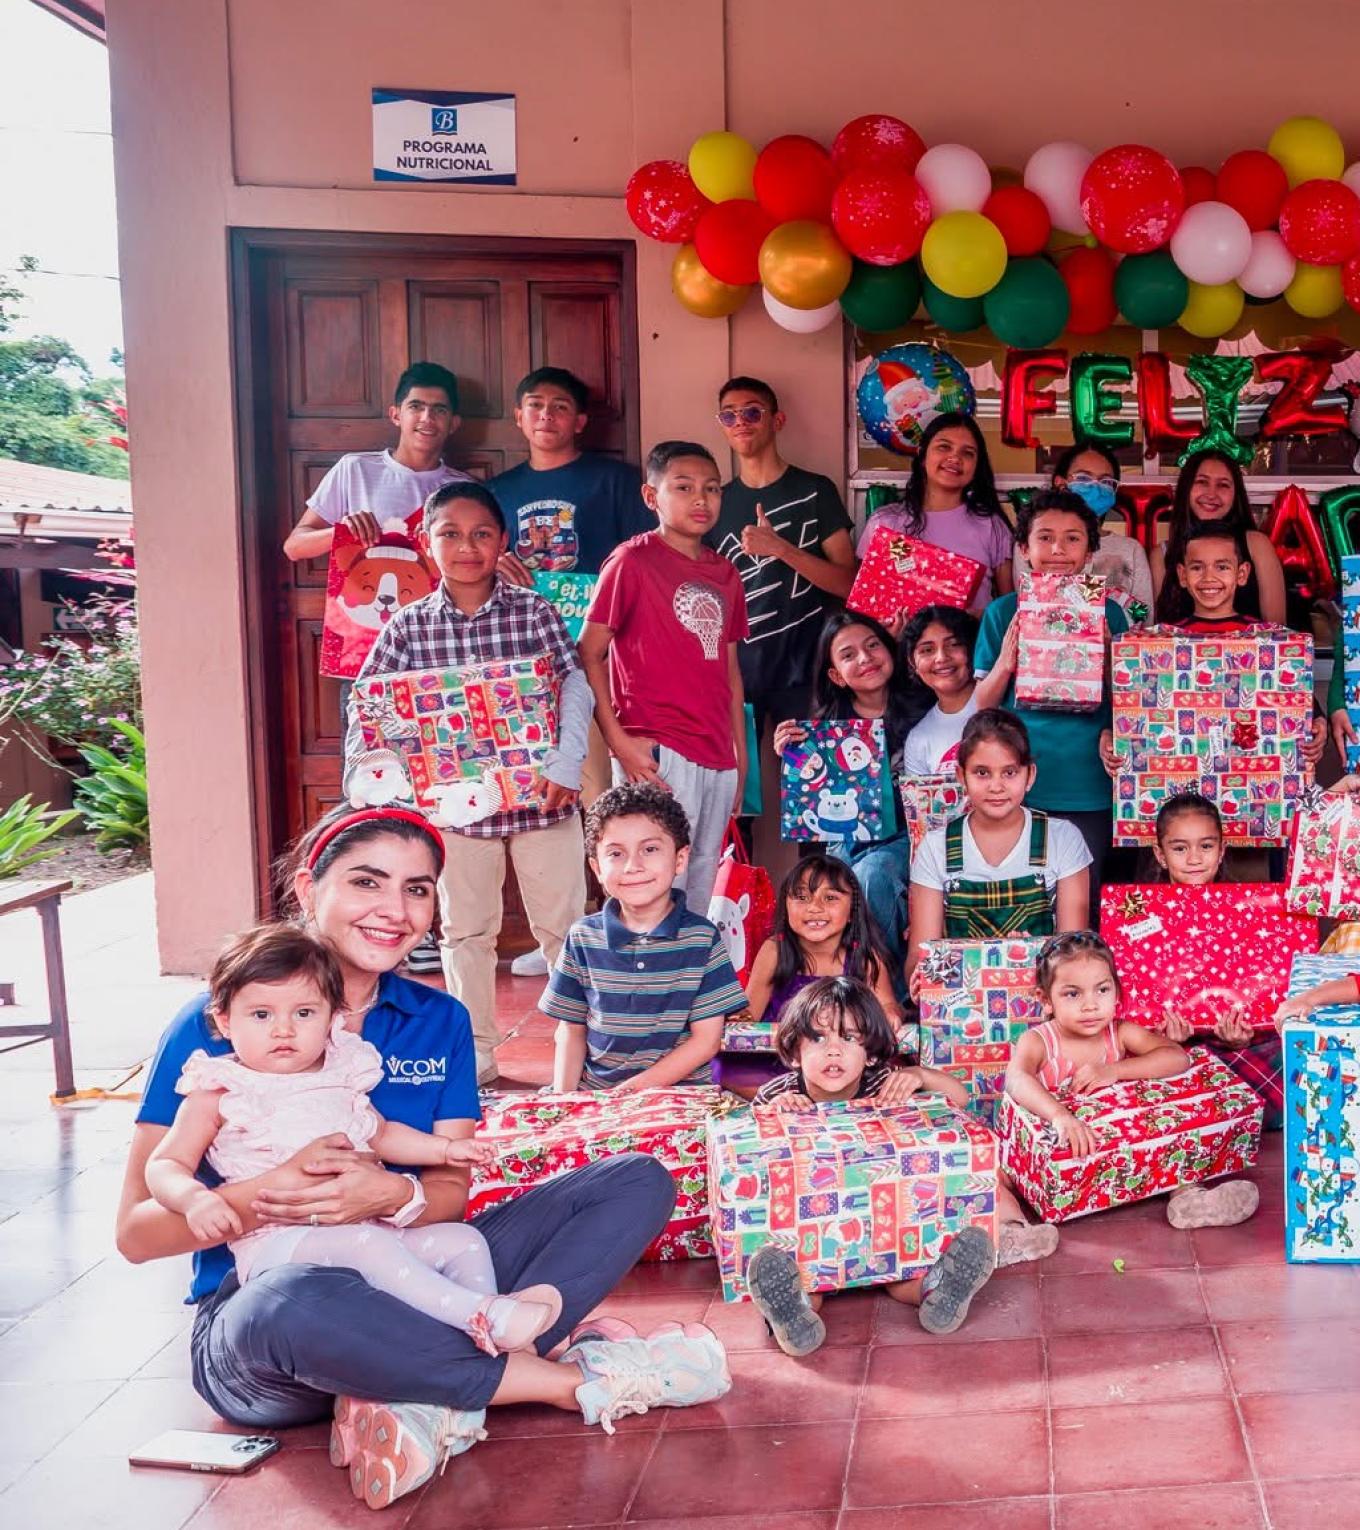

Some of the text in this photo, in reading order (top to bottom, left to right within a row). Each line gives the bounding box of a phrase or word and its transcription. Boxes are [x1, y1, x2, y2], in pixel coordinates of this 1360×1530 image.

[403, 140, 487, 155] PROGRAMA
[396, 156, 494, 172] NUTRICIONAL
[386, 1055, 446, 1076] VCOM
